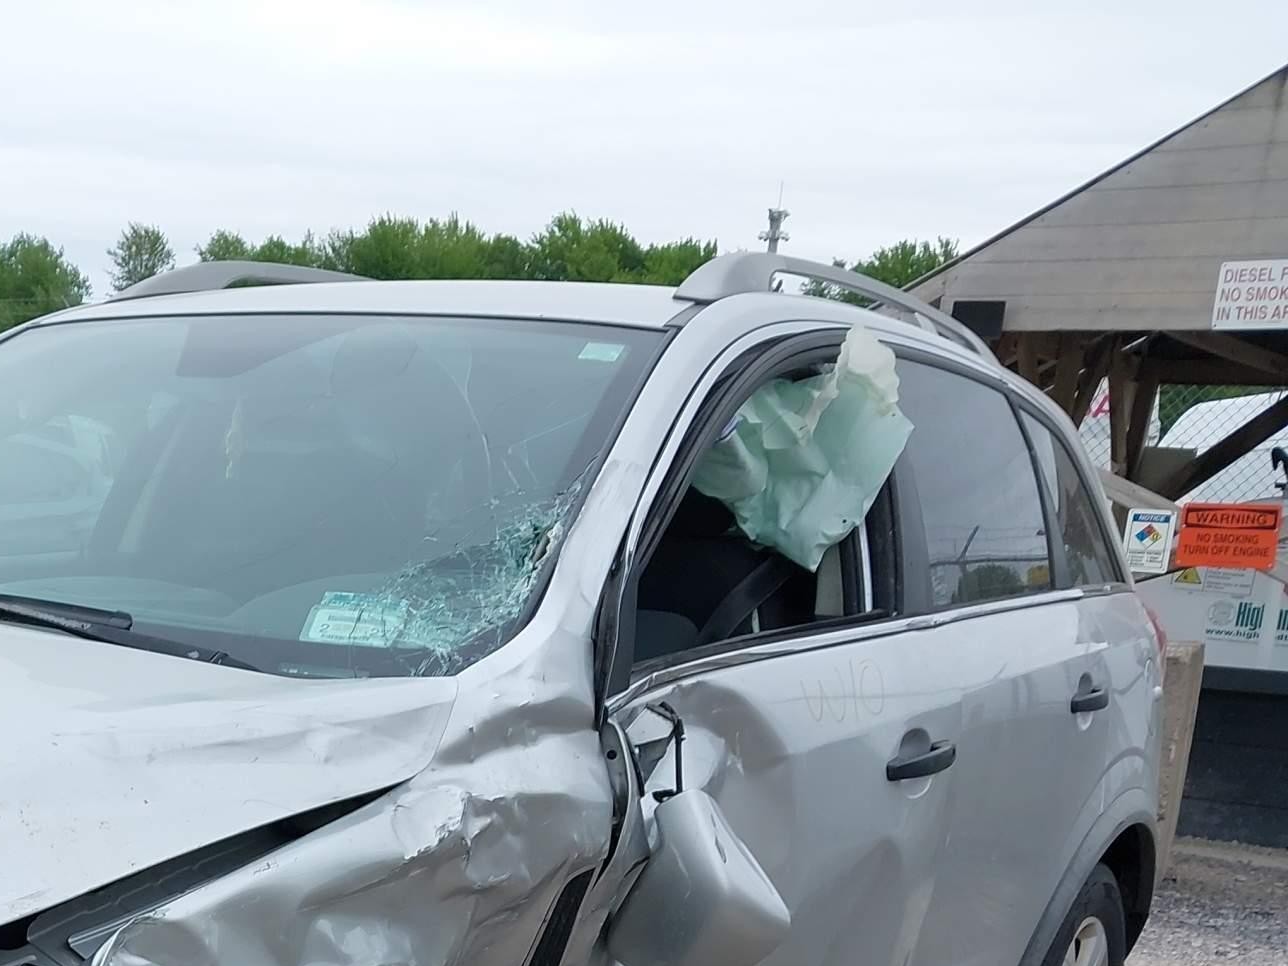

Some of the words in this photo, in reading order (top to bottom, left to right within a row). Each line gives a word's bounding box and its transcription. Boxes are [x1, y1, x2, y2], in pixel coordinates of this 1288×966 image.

[1223, 266, 1276, 284] DIESEL
[1219, 286, 1241, 302] NO
[1215, 306, 1232, 321] IN
[1235, 304, 1268, 321] THIS
[1196, 511, 1267, 525] WARNING
[1197, 533, 1211, 543] NO
[1213, 533, 1260, 545] SMOKING
[1183, 544, 1210, 555] TURN
[1211, 545, 1229, 556] OFF
[1232, 546, 1271, 558] ENGINE
